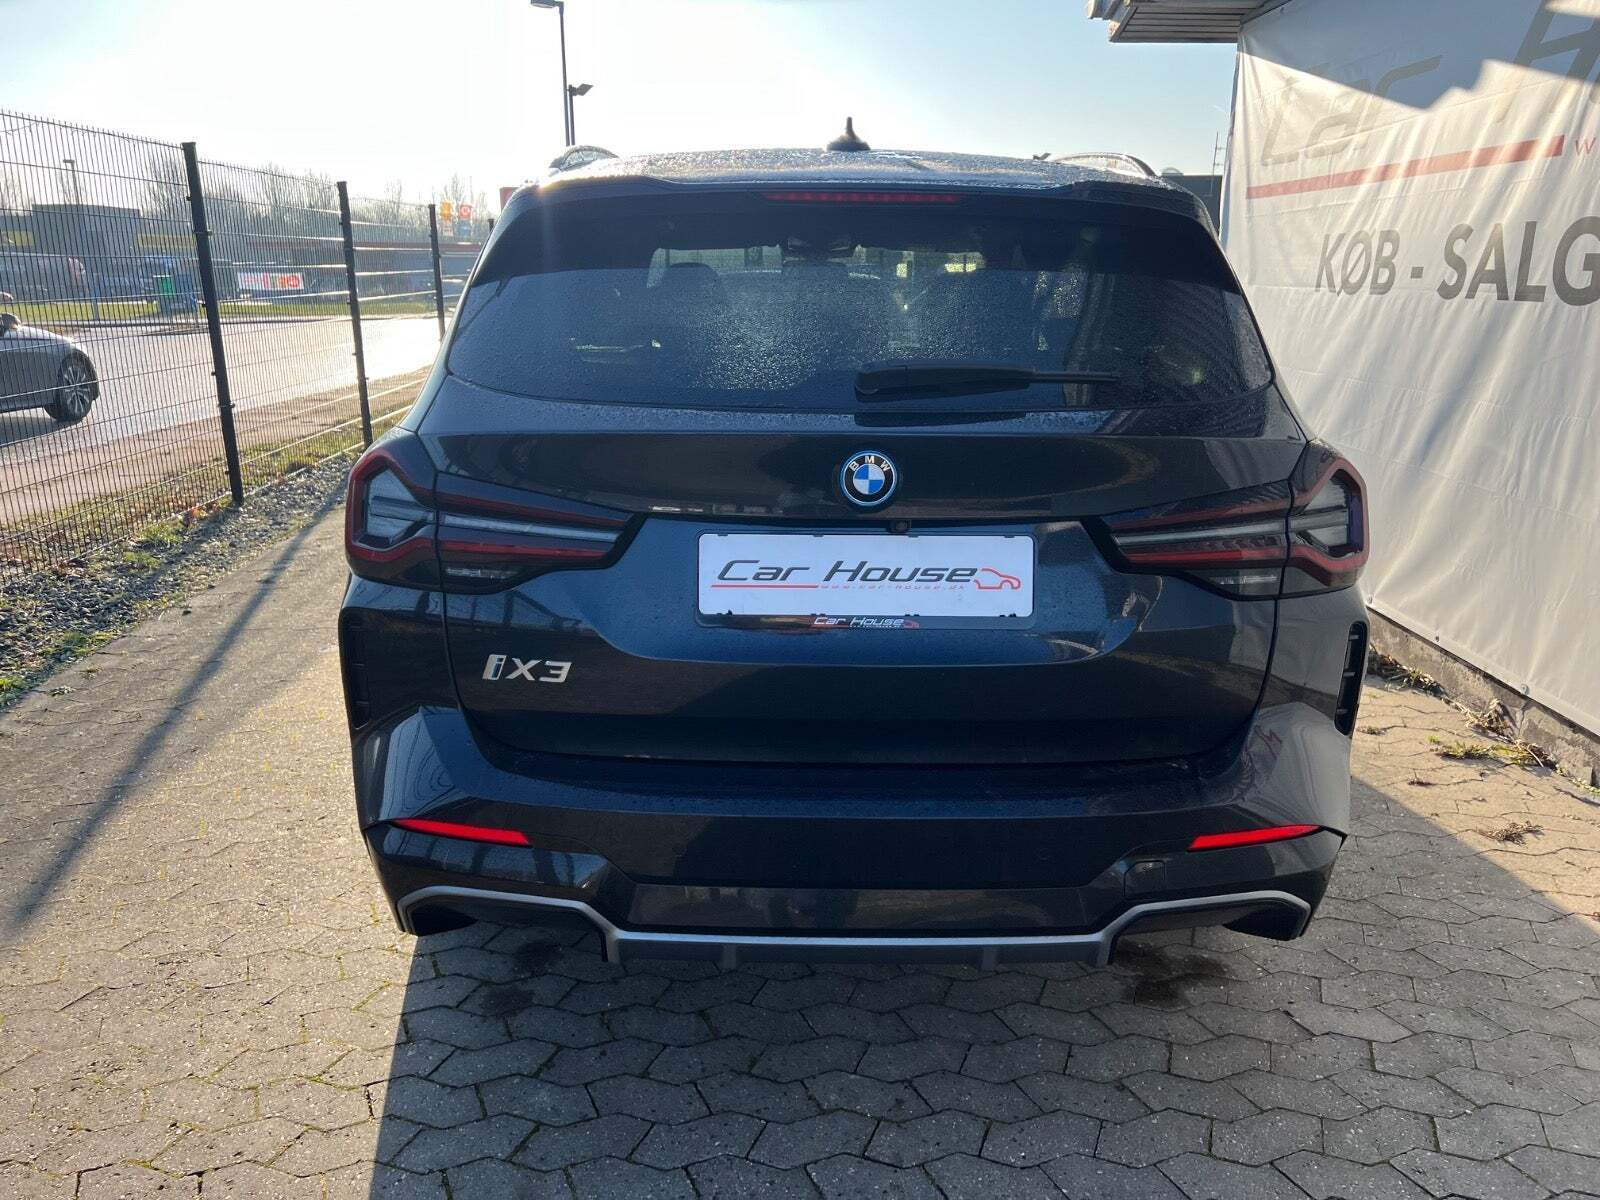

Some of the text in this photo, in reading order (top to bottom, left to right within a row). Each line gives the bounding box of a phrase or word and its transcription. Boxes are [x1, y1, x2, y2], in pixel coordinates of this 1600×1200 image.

[1314, 229, 1401, 297] KØB
[1436, 215, 1600, 306] SALG
[848, 455, 891, 471] BMW
[717, 559, 979, 583] Car House
[814, 616, 904, 626] Car House
[481, 653, 573, 683] iX3
